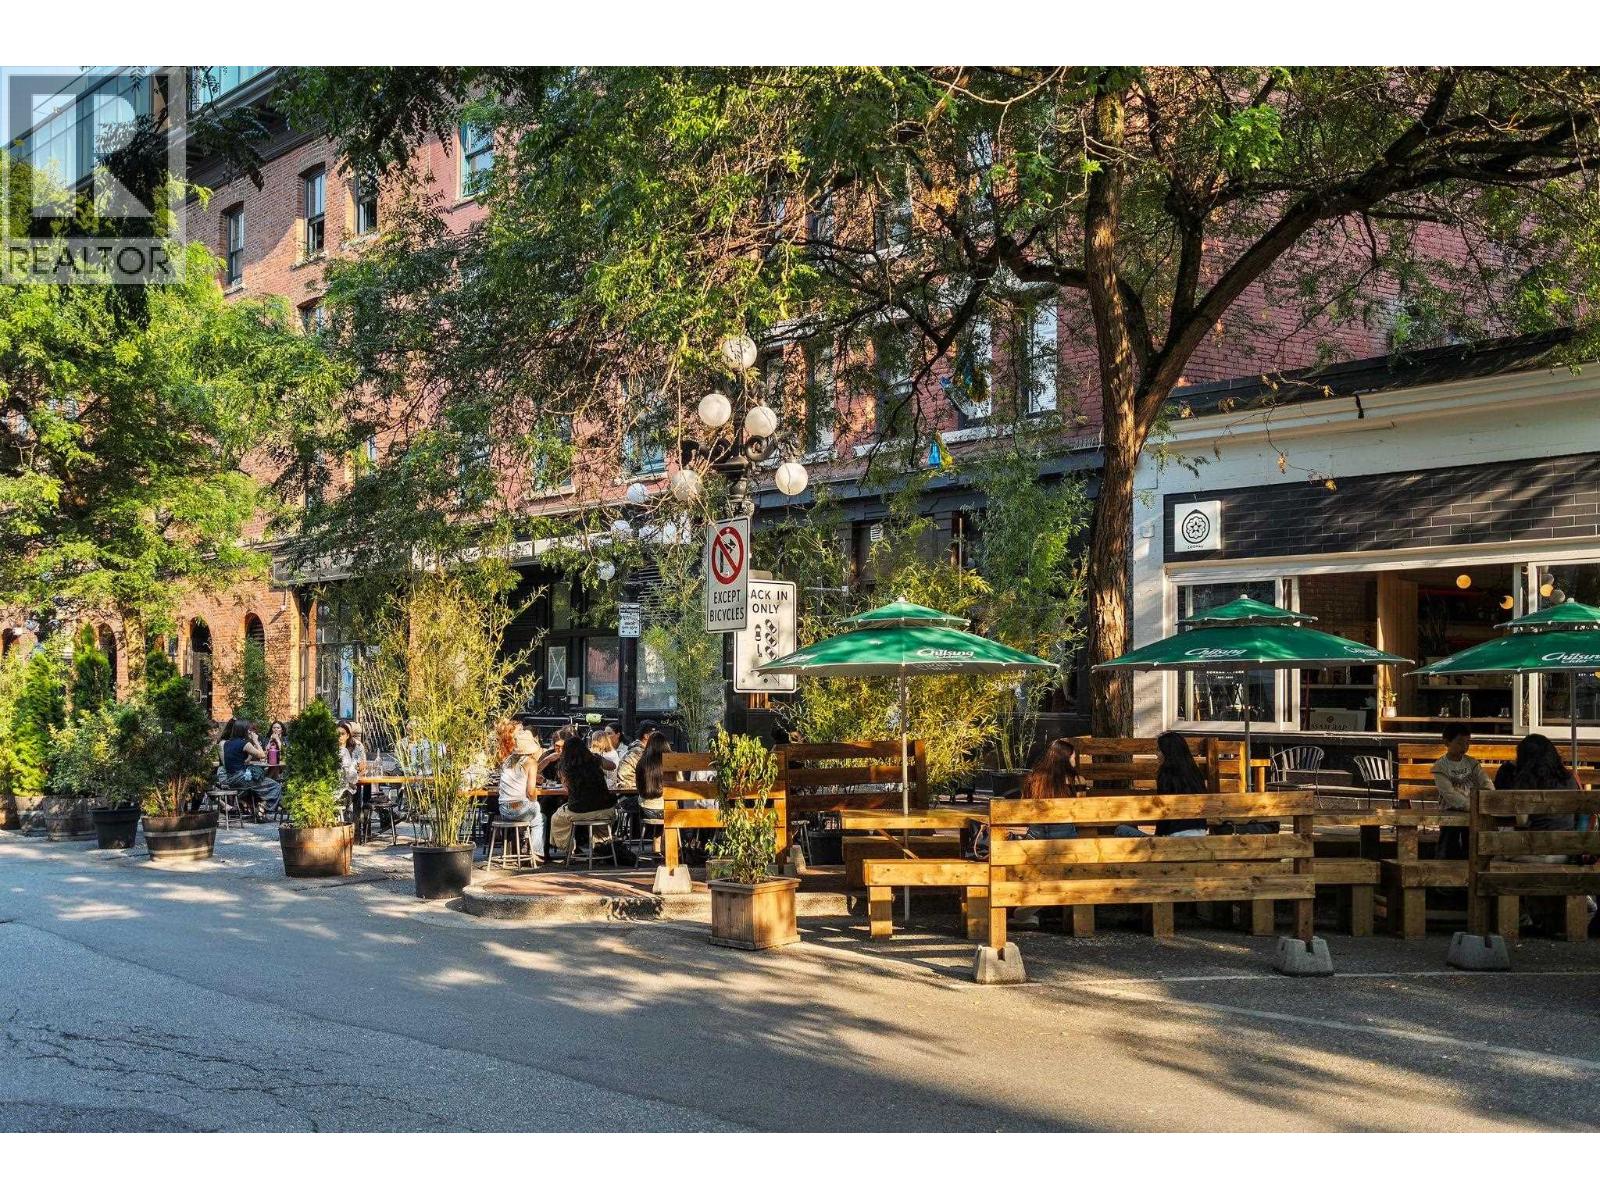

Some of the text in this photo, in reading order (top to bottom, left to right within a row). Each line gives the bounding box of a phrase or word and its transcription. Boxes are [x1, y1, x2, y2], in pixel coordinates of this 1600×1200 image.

[713, 589, 741, 604] EXCEPT
[751, 590, 788, 601] ACK IN
[752, 603, 780, 614] ONLY
[709, 607, 744, 622] BICYCLES
[1541, 651, 1600, 660] Chilsun
